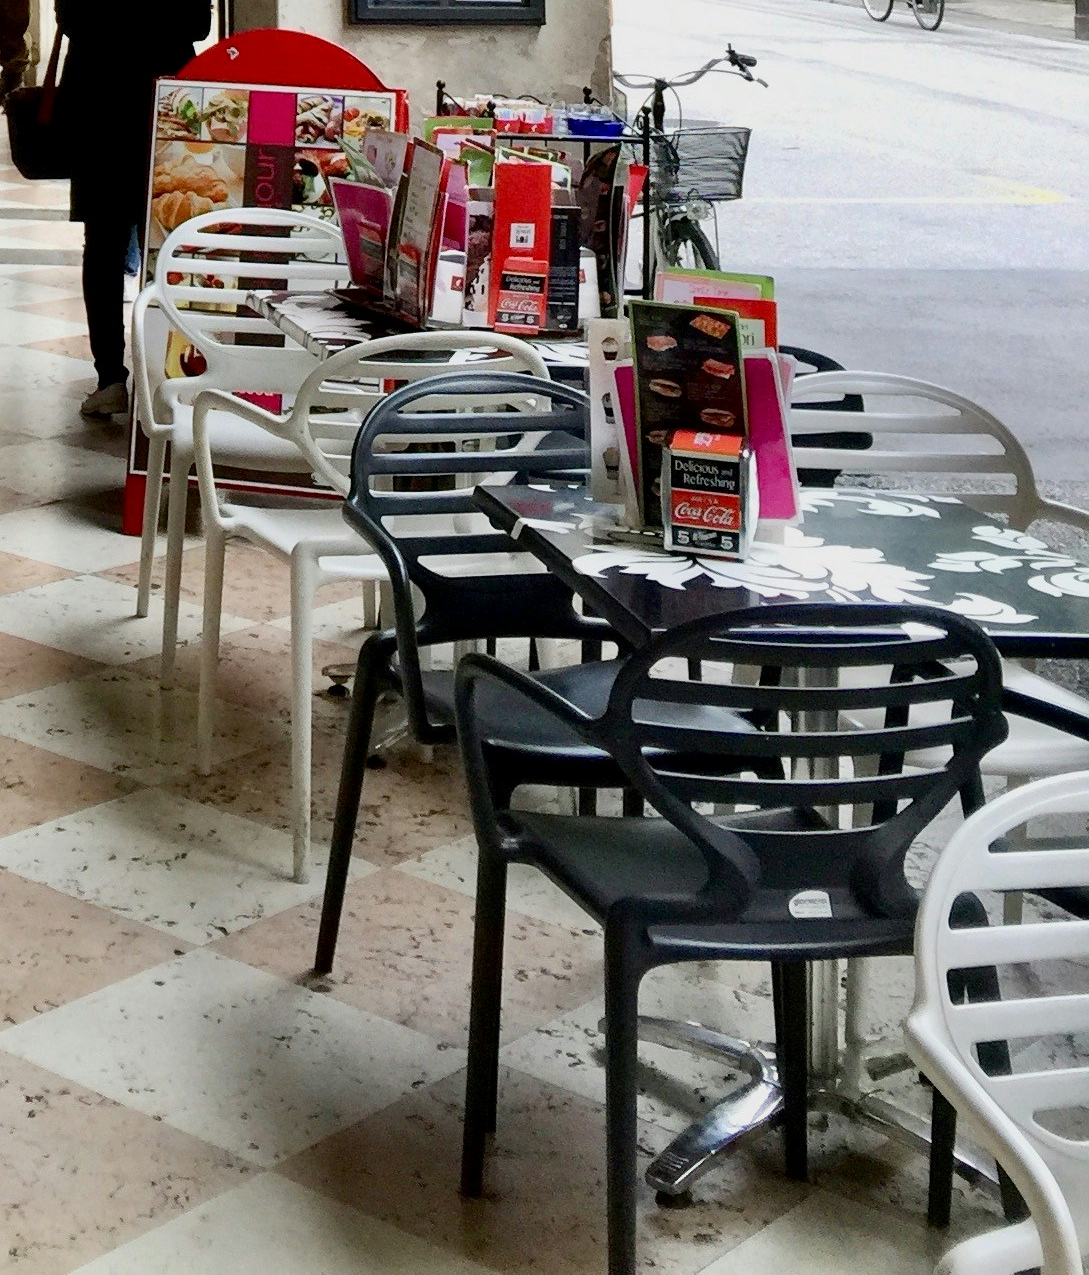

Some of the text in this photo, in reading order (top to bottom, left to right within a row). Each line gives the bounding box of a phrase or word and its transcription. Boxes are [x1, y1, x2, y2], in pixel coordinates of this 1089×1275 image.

[674, 459, 720, 475] Delicious
[683, 473, 736, 491] Refreshing
[677, 530, 690, 544] 5
[720, 535, 734, 550] 5
